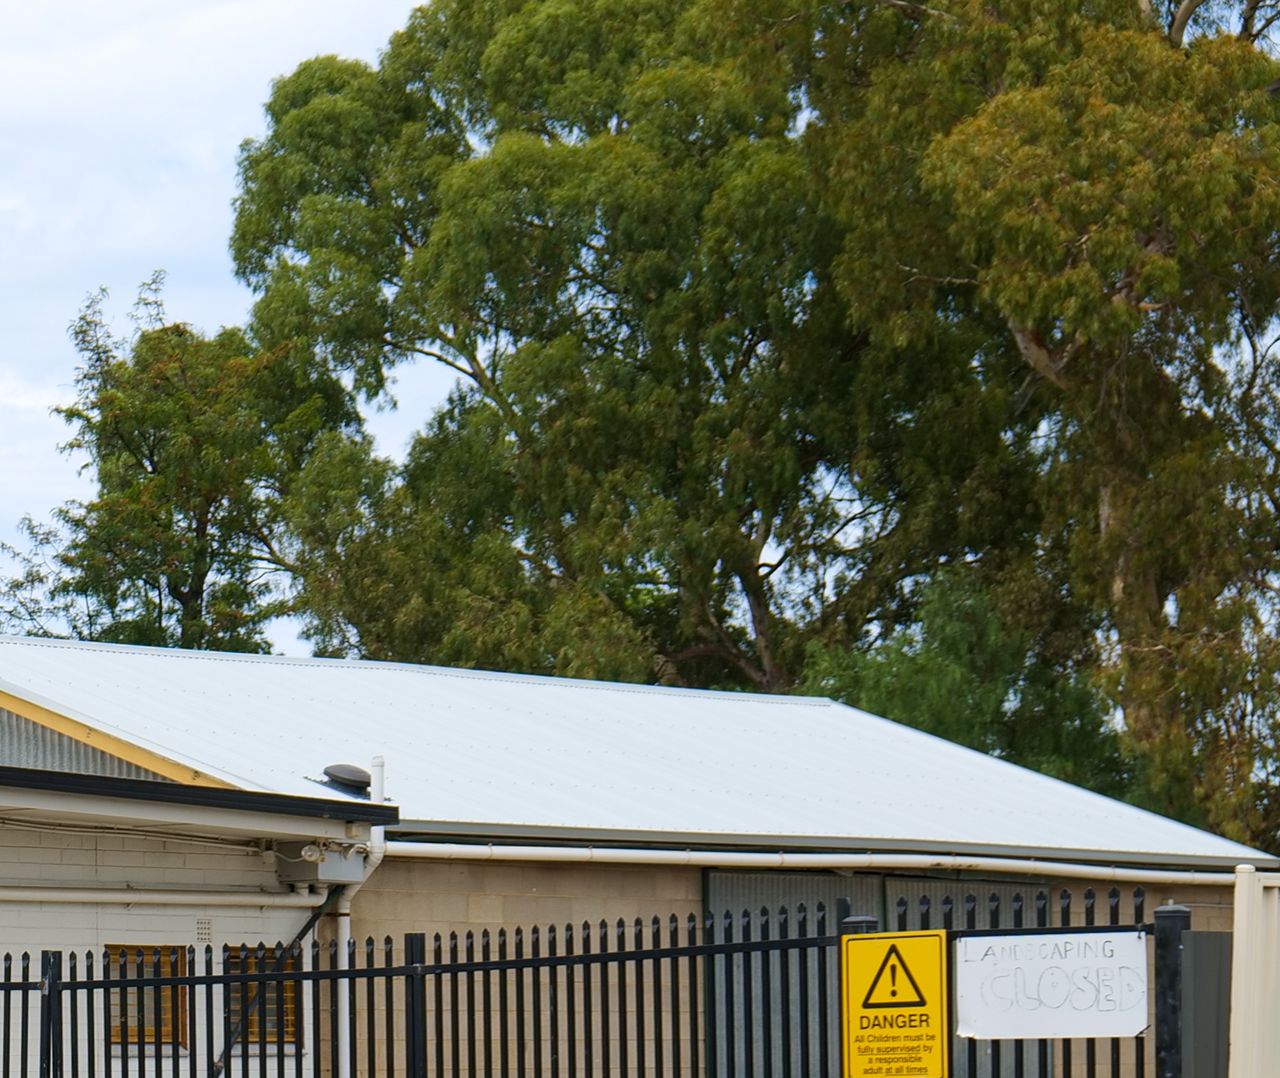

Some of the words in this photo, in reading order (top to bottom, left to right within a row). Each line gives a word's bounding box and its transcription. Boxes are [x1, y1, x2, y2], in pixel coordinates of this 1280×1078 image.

[980, 965, 1146, 1012] CLOSED
[860, 1013, 930, 1030] DANGER
[854, 1035, 865, 1043] All
[867, 1034, 901, 1043] Children
[903, 1034, 924, 1042] must
[925, 1033, 936, 1041] be
[857, 1045, 874, 1054] fully
[876, 1044, 921, 1054] supervised
[923, 1044, 933, 1054] by
[875, 1055, 922, 1065] responsible
[885, 1066, 892, 1074] at
